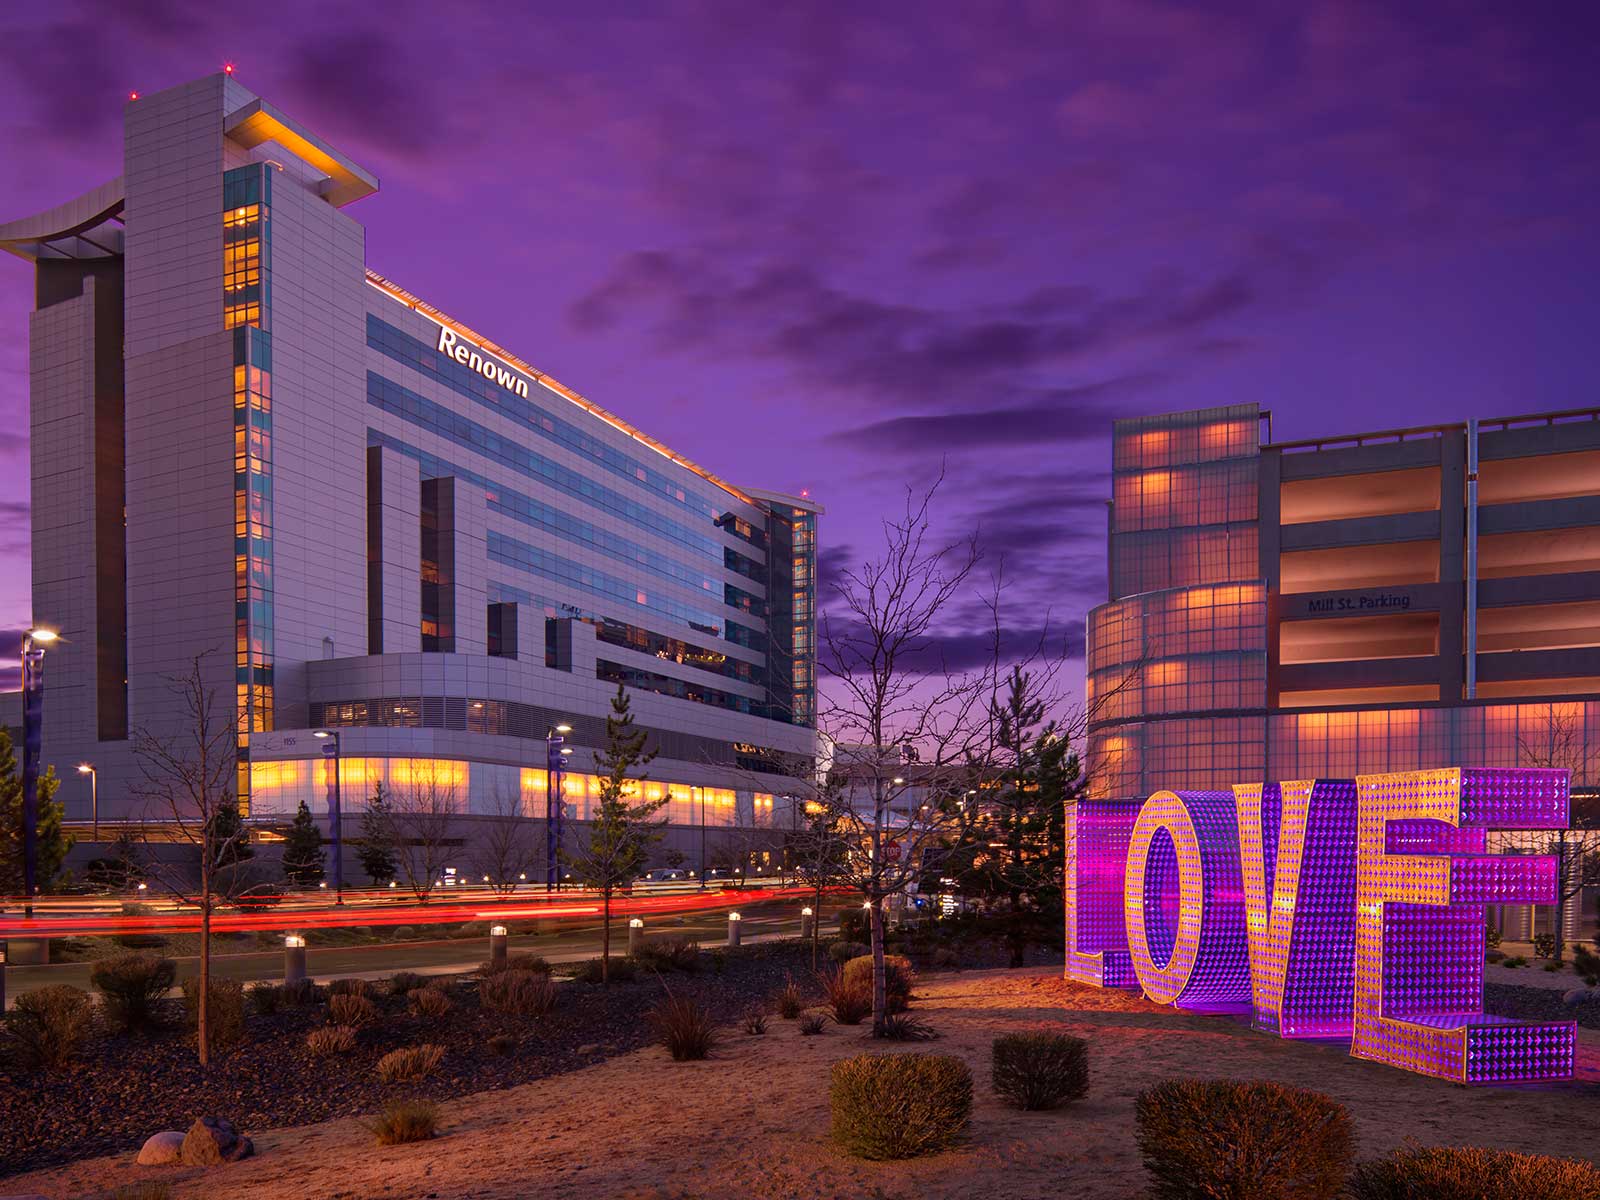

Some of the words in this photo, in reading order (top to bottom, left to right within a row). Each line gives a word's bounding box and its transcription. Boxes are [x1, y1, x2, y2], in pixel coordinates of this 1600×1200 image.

[438, 326, 529, 398] Renown
[1308, 598, 1333, 612] Mill
[1337, 597, 1355, 610] St.
[1359, 594, 1410, 609] Parking
[881, 847, 901, 857] STOP
[1064, 767, 1577, 1087] LOVE
